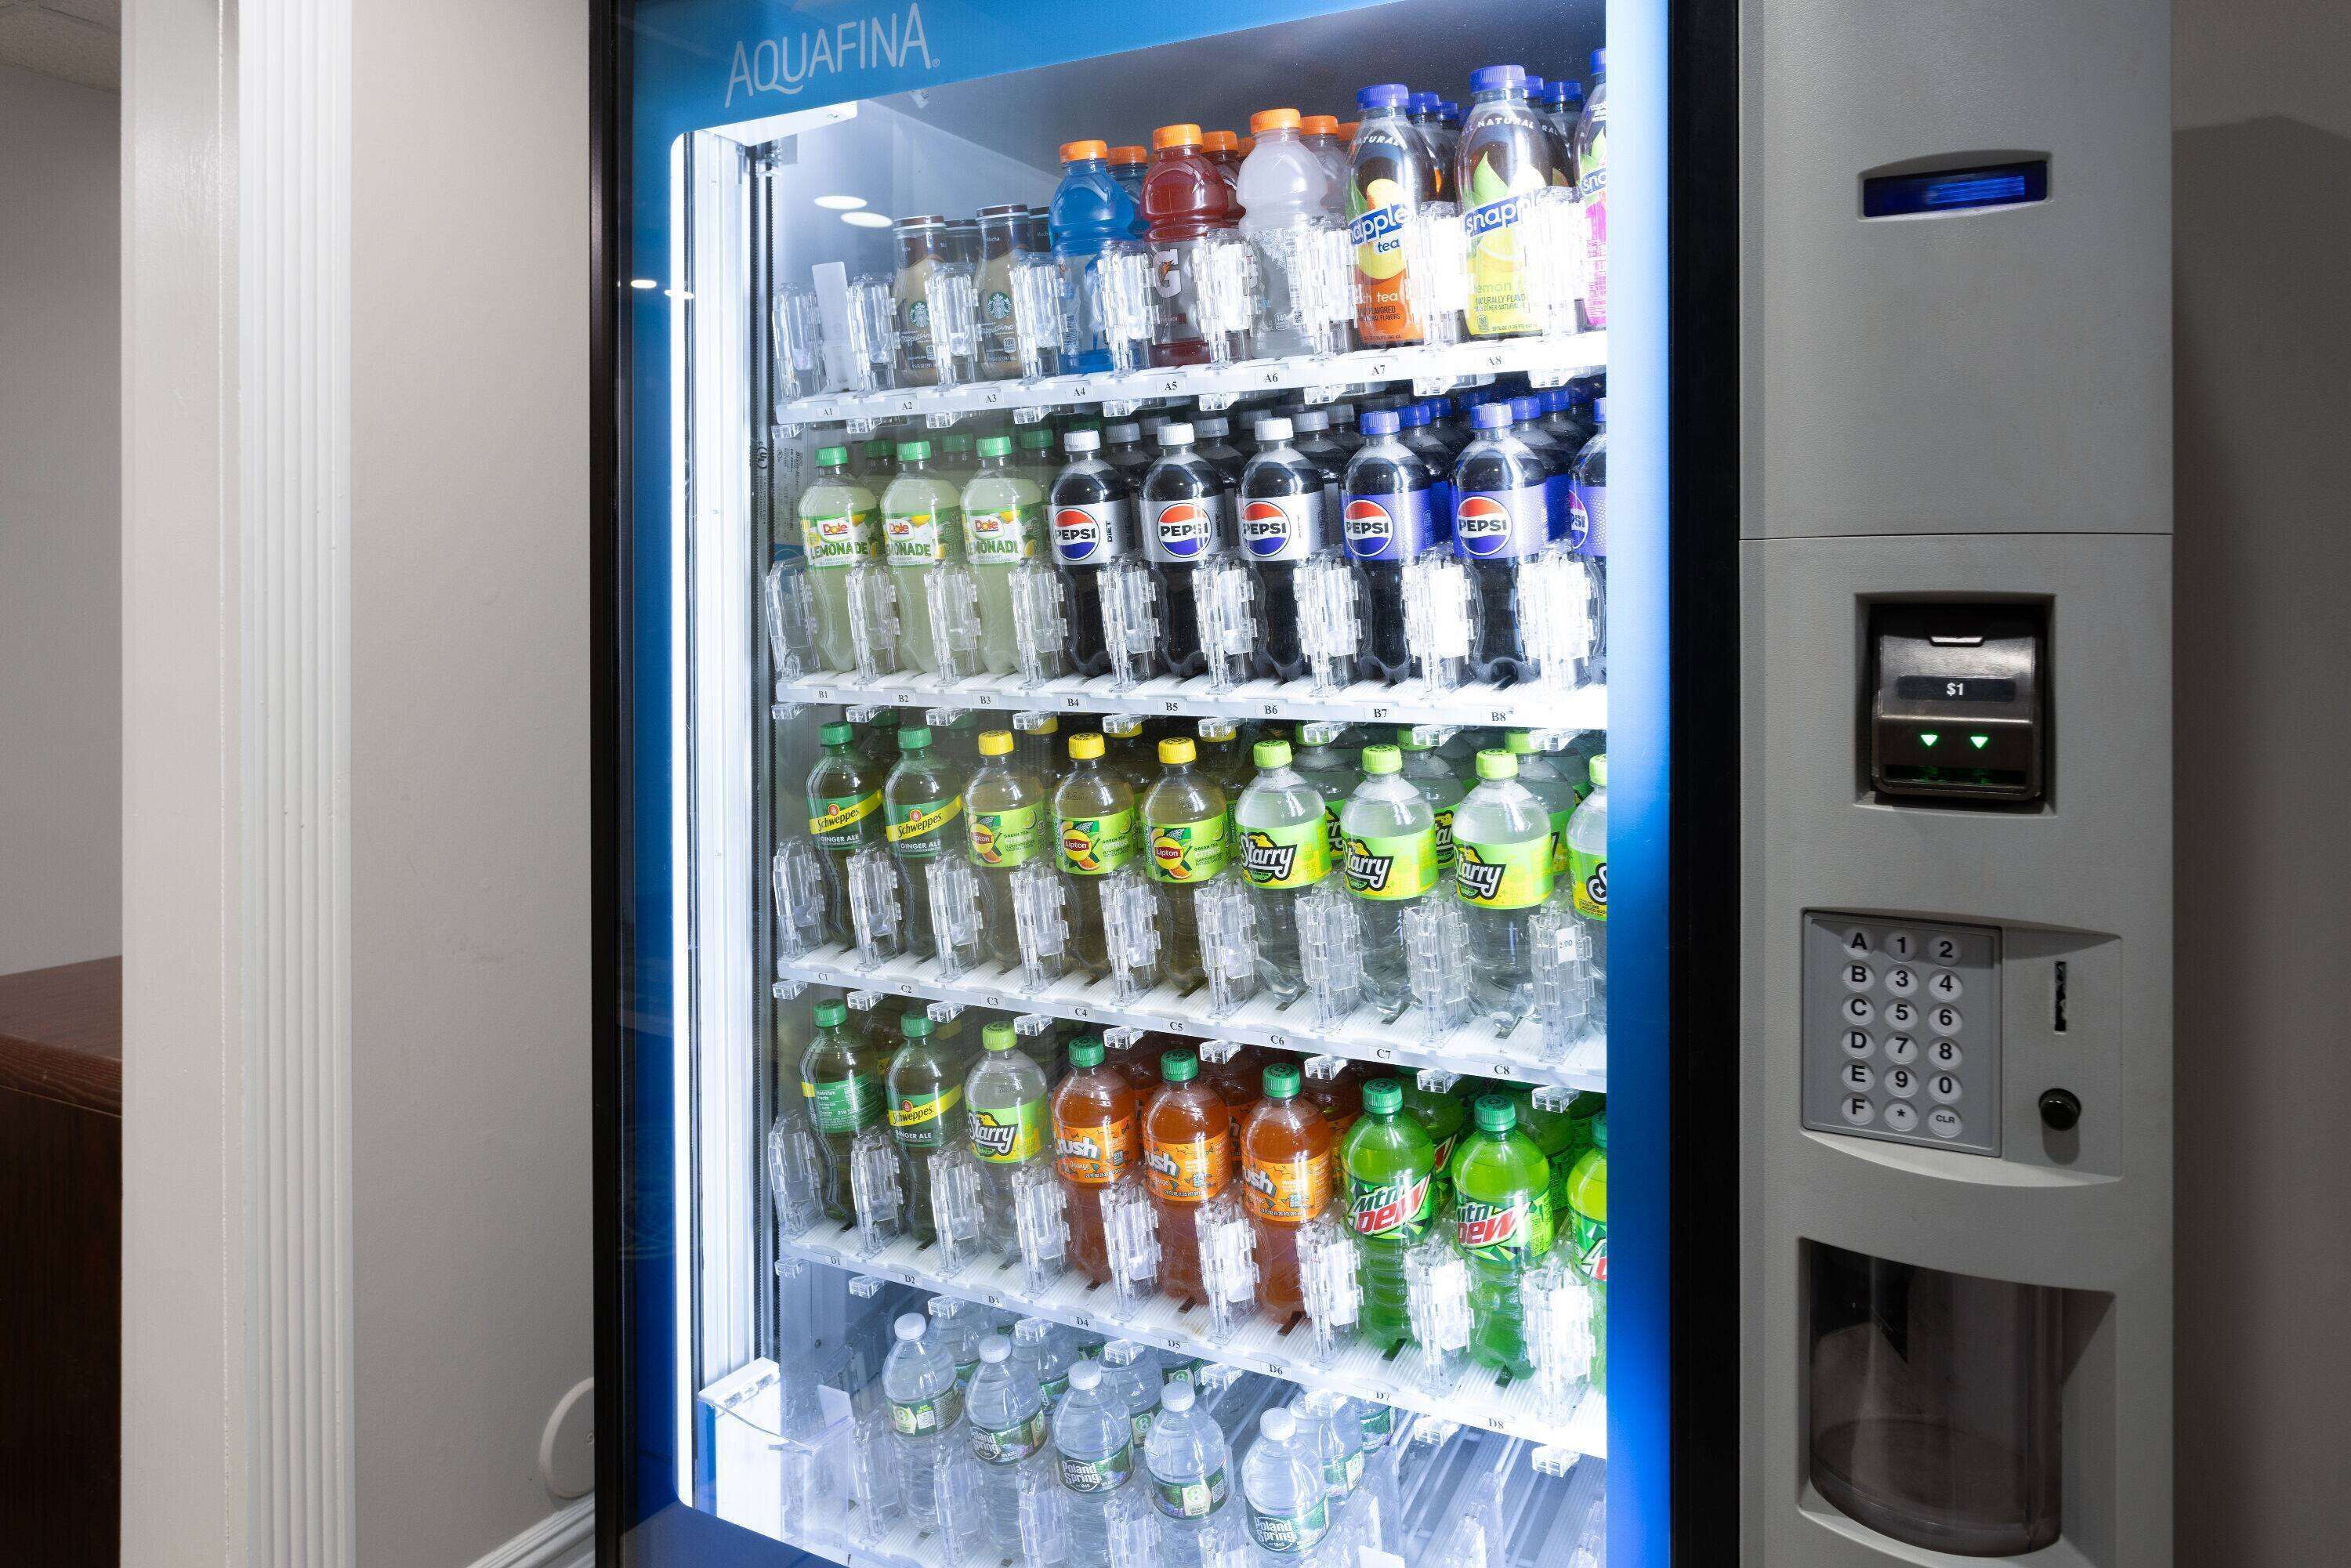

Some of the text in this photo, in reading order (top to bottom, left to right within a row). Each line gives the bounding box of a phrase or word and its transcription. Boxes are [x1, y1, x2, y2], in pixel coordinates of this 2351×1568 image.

[724, 2, 932, 108] AQUAFINA
[1477, 118, 1534, 129] NATURAL
[1347, 202, 1408, 244] napple
[1466, 202, 1518, 237] snap
[1377, 238, 1400, 252] tea
[1152, 249, 1181, 298] G
[1377, 292, 1398, 302] tea
[1487, 355, 1502, 365] A8
[1371, 364, 1386, 375] A7
[1264, 371, 1278, 382] A6
[1074, 386, 1085, 397] A4
[1164, 381, 1177, 391] A5
[986, 394, 997, 403] A3
[902, 402, 912, 411] A2
[823, 522, 848, 534] Dole
[889, 522, 909, 534] Dole
[974, 520, 999, 531] Dole
[1161, 523, 1208, 537] PEPSI
[1243, 523, 1286, 534] PEPSI
[1346, 521, 1389, 534] PEPSI
[1458, 519, 1507, 531] PEPSI
[1055, 527, 1096, 540] PEPSI
[818, 690, 828, 698] B1
[1946, 682, 1964, 697] $1
[899, 693, 908, 703] B2
[980, 695, 991, 704] B3
[1067, 697, 1079, 707] B4
[1165, 702, 1177, 711] B5
[1264, 705, 1277, 715] B6
[1374, 708, 1387, 718] B7
[1491, 712, 1506, 722] B8
[817, 808, 860, 831] Schweppes
[898, 813, 942, 838] Schweppes
[972, 834, 991, 844] Lipton
[1065, 840, 1087, 849] Lipton
[1156, 848, 1179, 858] Lipton
[1241, 834, 1294, 878] Starry
[1851, 932, 1952, 958] A 1 2
[818, 972, 828, 981] C1
[1852, 966, 1952, 992] B 3 4
[901, 984, 911, 993] C2
[987, 996, 998, 1006] C3
[1075, 1007, 1087, 1017] C4
[1851, 999, 1952, 1026] C 5 6
[1169, 1021, 1183, 1031] C5
[1270, 1034, 1284, 1045] C6
[1852, 1032, 1952, 1060] D 7 8
[1376, 1048, 1391, 1059] C7
[1494, 1064, 1510, 1075] C8
[1852, 1066, 1951, 1094] E 9 0
[893, 1104, 933, 1124] Schweppes
[1852, 1099, 1955, 1124] F CLR
[969, 1112, 1015, 1155] Starry
[1057, 1136, 1100, 1161] ush
[1144, 1150, 1180, 1179] ush
[831, 1256, 840, 1266] D1
[904, 1274, 915, 1284] D2
[1076, 1316, 1089, 1327] D4
[1167, 1339, 1180, 1349] D5
[1269, 1363, 1283, 1374] D6
[1489, 1418, 1505, 1429] D8
[972, 1431, 997, 1443] oland
[1063, 1461, 1097, 1475] Poland
[1066, 1472, 1100, 1485] Spring
[1255, 1517, 1292, 1533] Poland
[1256, 1529, 1297, 1543] Spring
